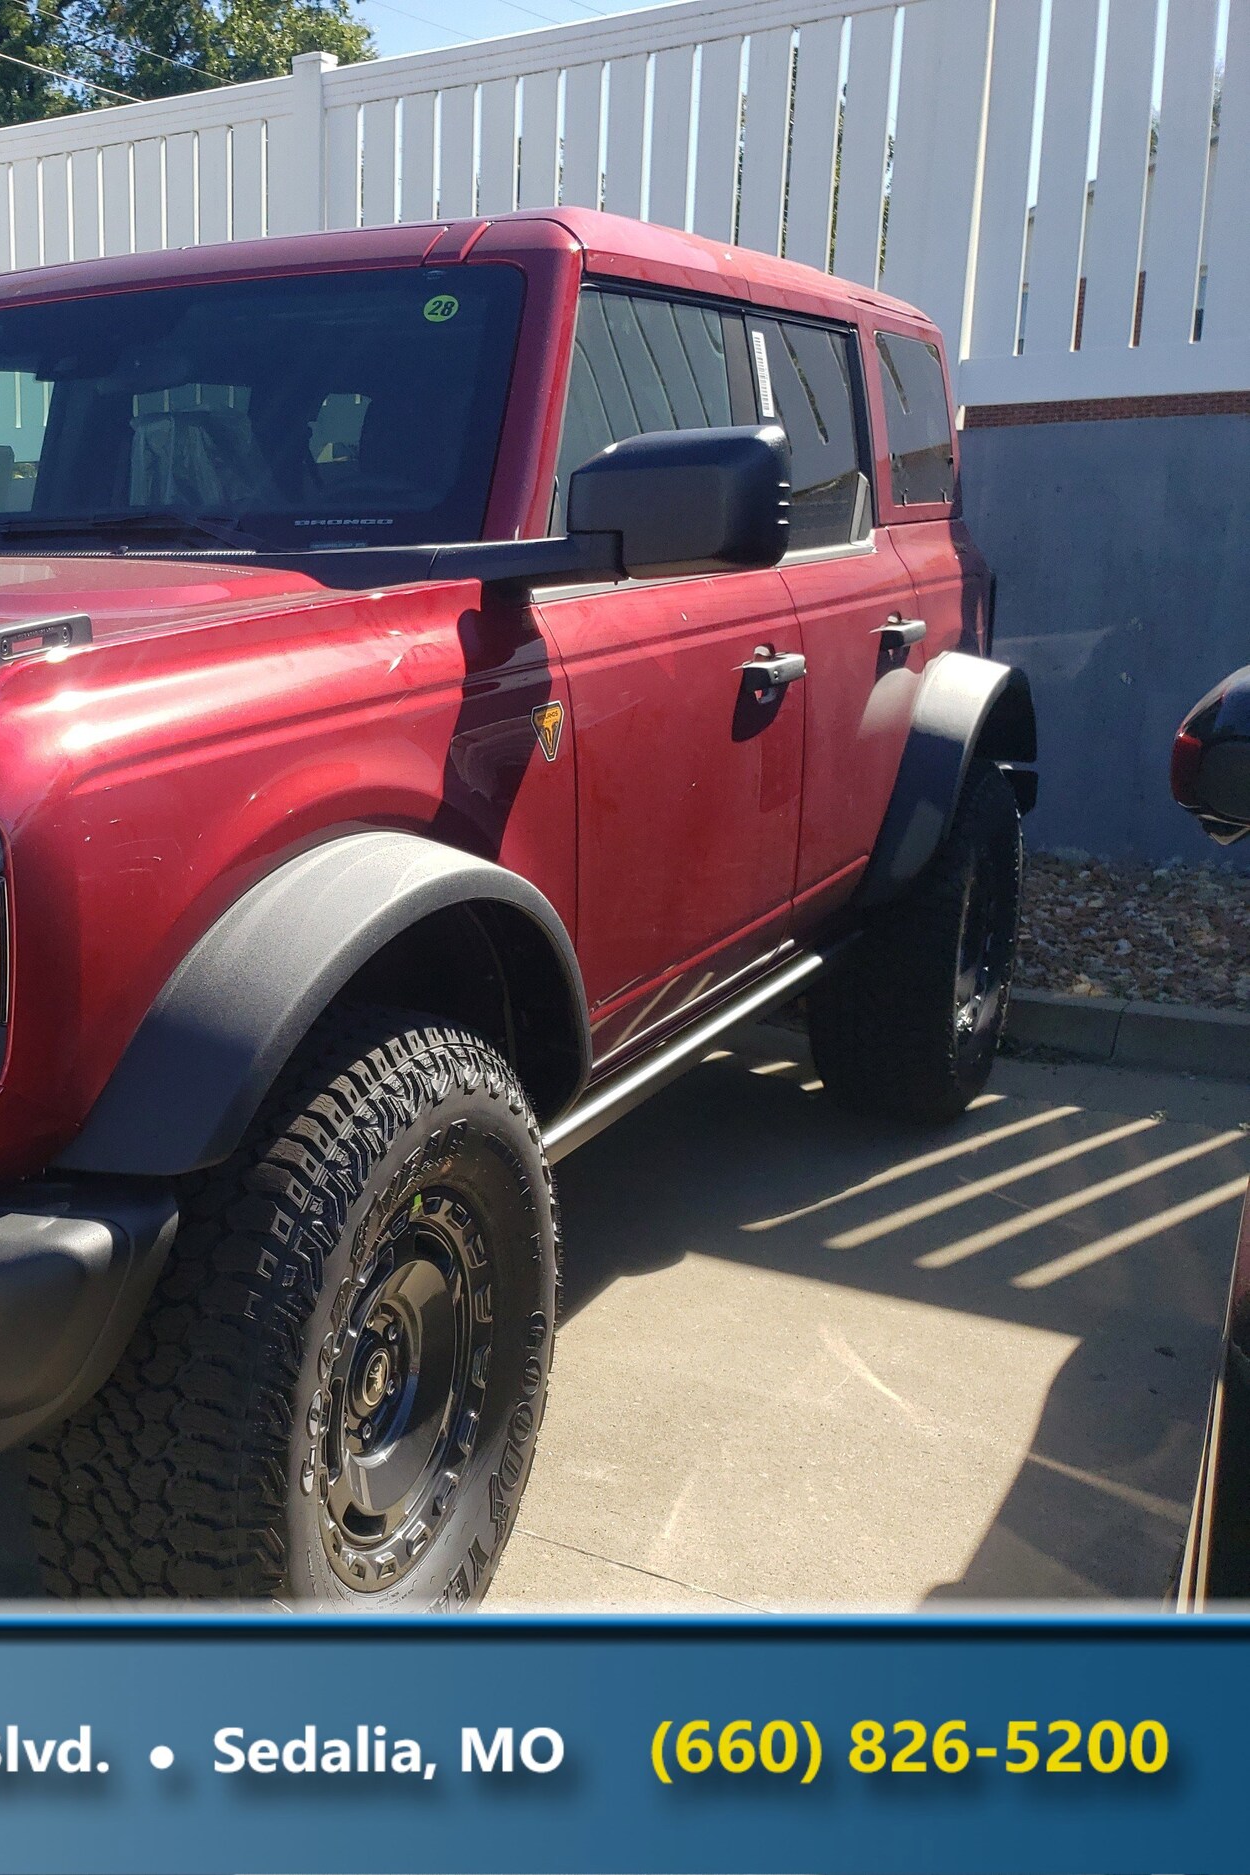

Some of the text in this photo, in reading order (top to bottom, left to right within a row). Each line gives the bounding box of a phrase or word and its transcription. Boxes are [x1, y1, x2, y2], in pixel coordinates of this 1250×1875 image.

[427, 300, 456, 317] 28
[294, 518, 394, 527] BRONCO
[425, 1309, 548, 1613] GOODYE
